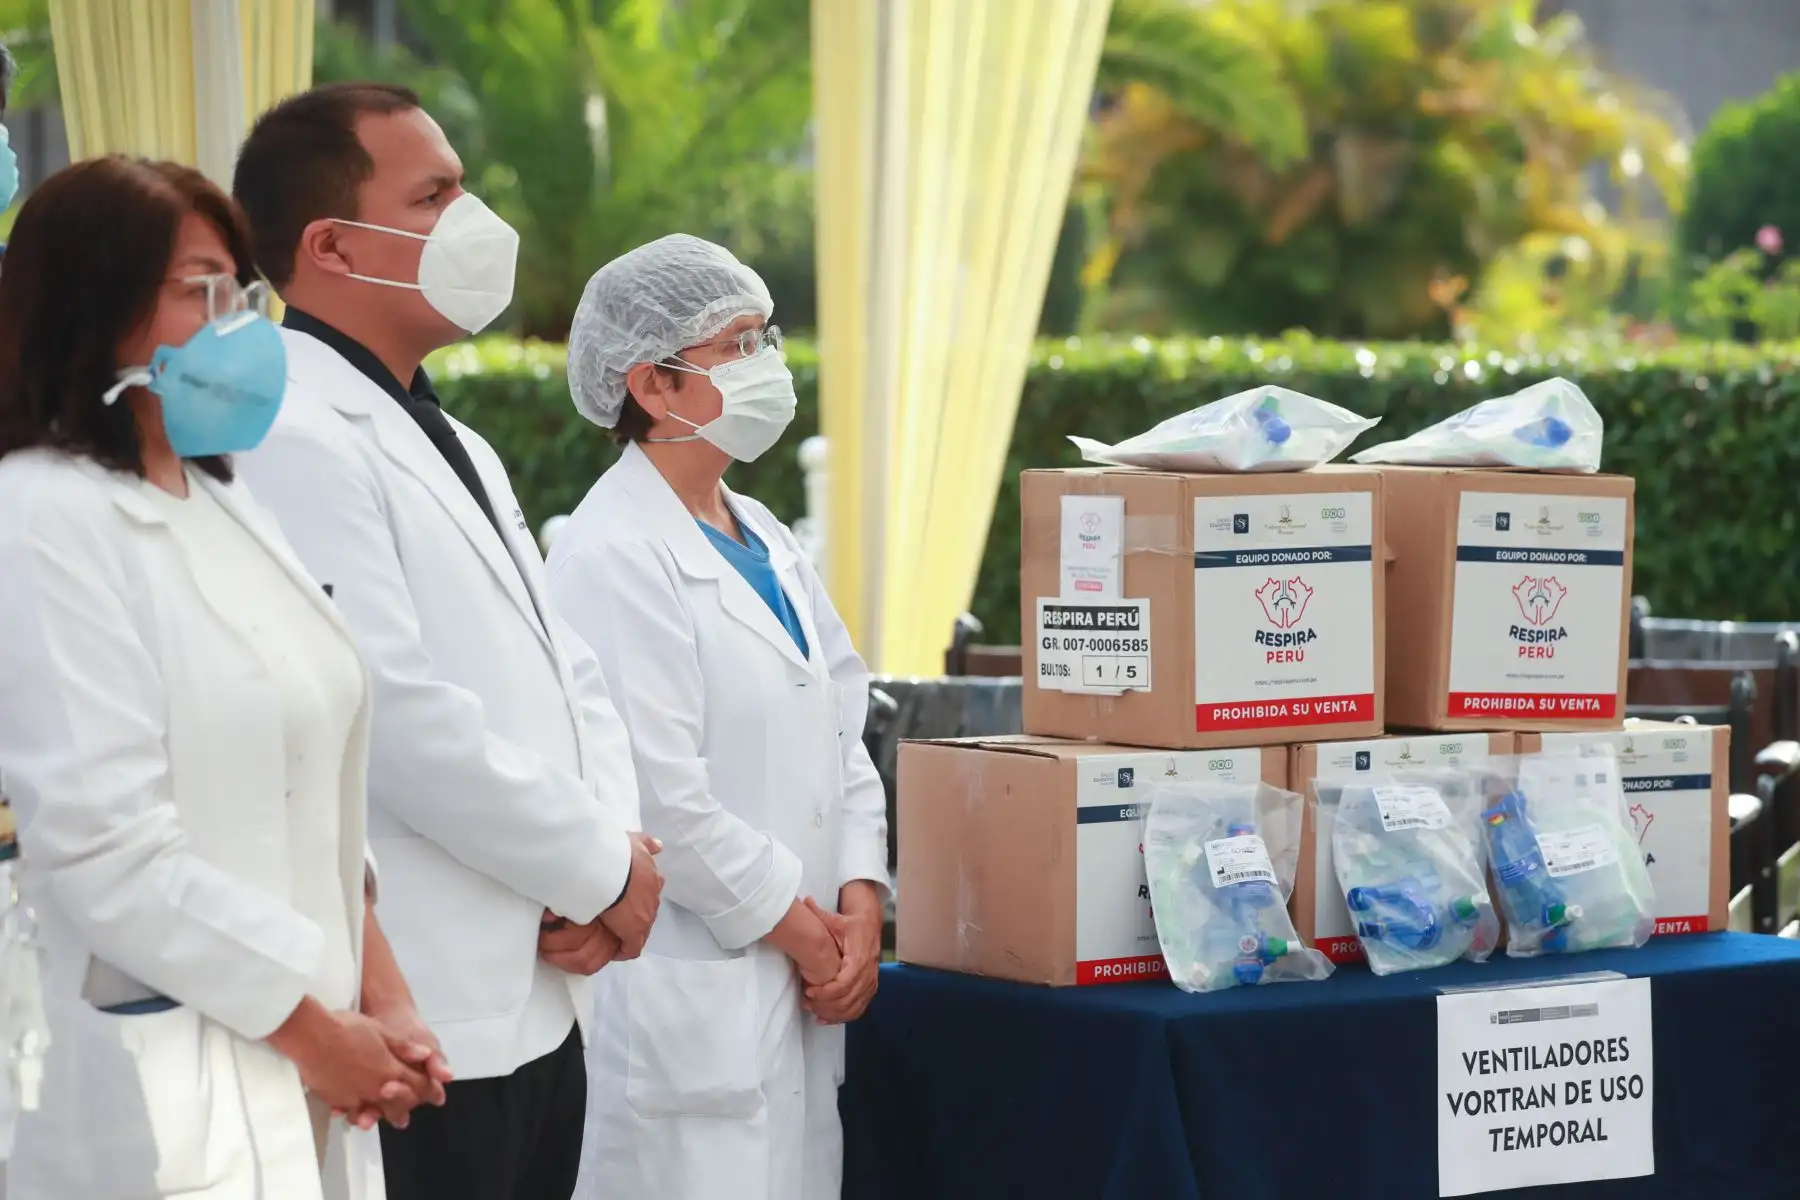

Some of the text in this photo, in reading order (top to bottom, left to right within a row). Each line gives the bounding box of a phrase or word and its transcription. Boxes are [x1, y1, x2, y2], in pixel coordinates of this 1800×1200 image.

[1236, 551, 1333, 564] EQUIPO DONADO POR:
[1496, 551, 1587, 562] EQUIPO DONADO POR:
[1043, 609, 1139, 627] RESPIRA PERÚ
[1255, 627, 1317, 647] RESPIRA
[1509, 624, 1568, 643] RESPIRA
[1042, 637, 1148, 652] GR. 007-0006585
[1518, 644, 1554, 659] PERÚ
[1266, 646, 1304, 664] PERÚ
[1041, 663, 1071, 677] BULTOS:
[1096, 665, 1102, 678] 1
[1126, 665, 1137, 678] 5
[1213, 700, 1357, 720] PROHIBIDA SU VENTA
[1464, 698, 1600, 711] PROHIBIDA SU VENTA
[1462, 1036, 1630, 1077] VENTILADORES
[1447, 1074, 1644, 1117] VORTRAN DE USO
[1489, 1117, 1608, 1152] TEMPORAL
